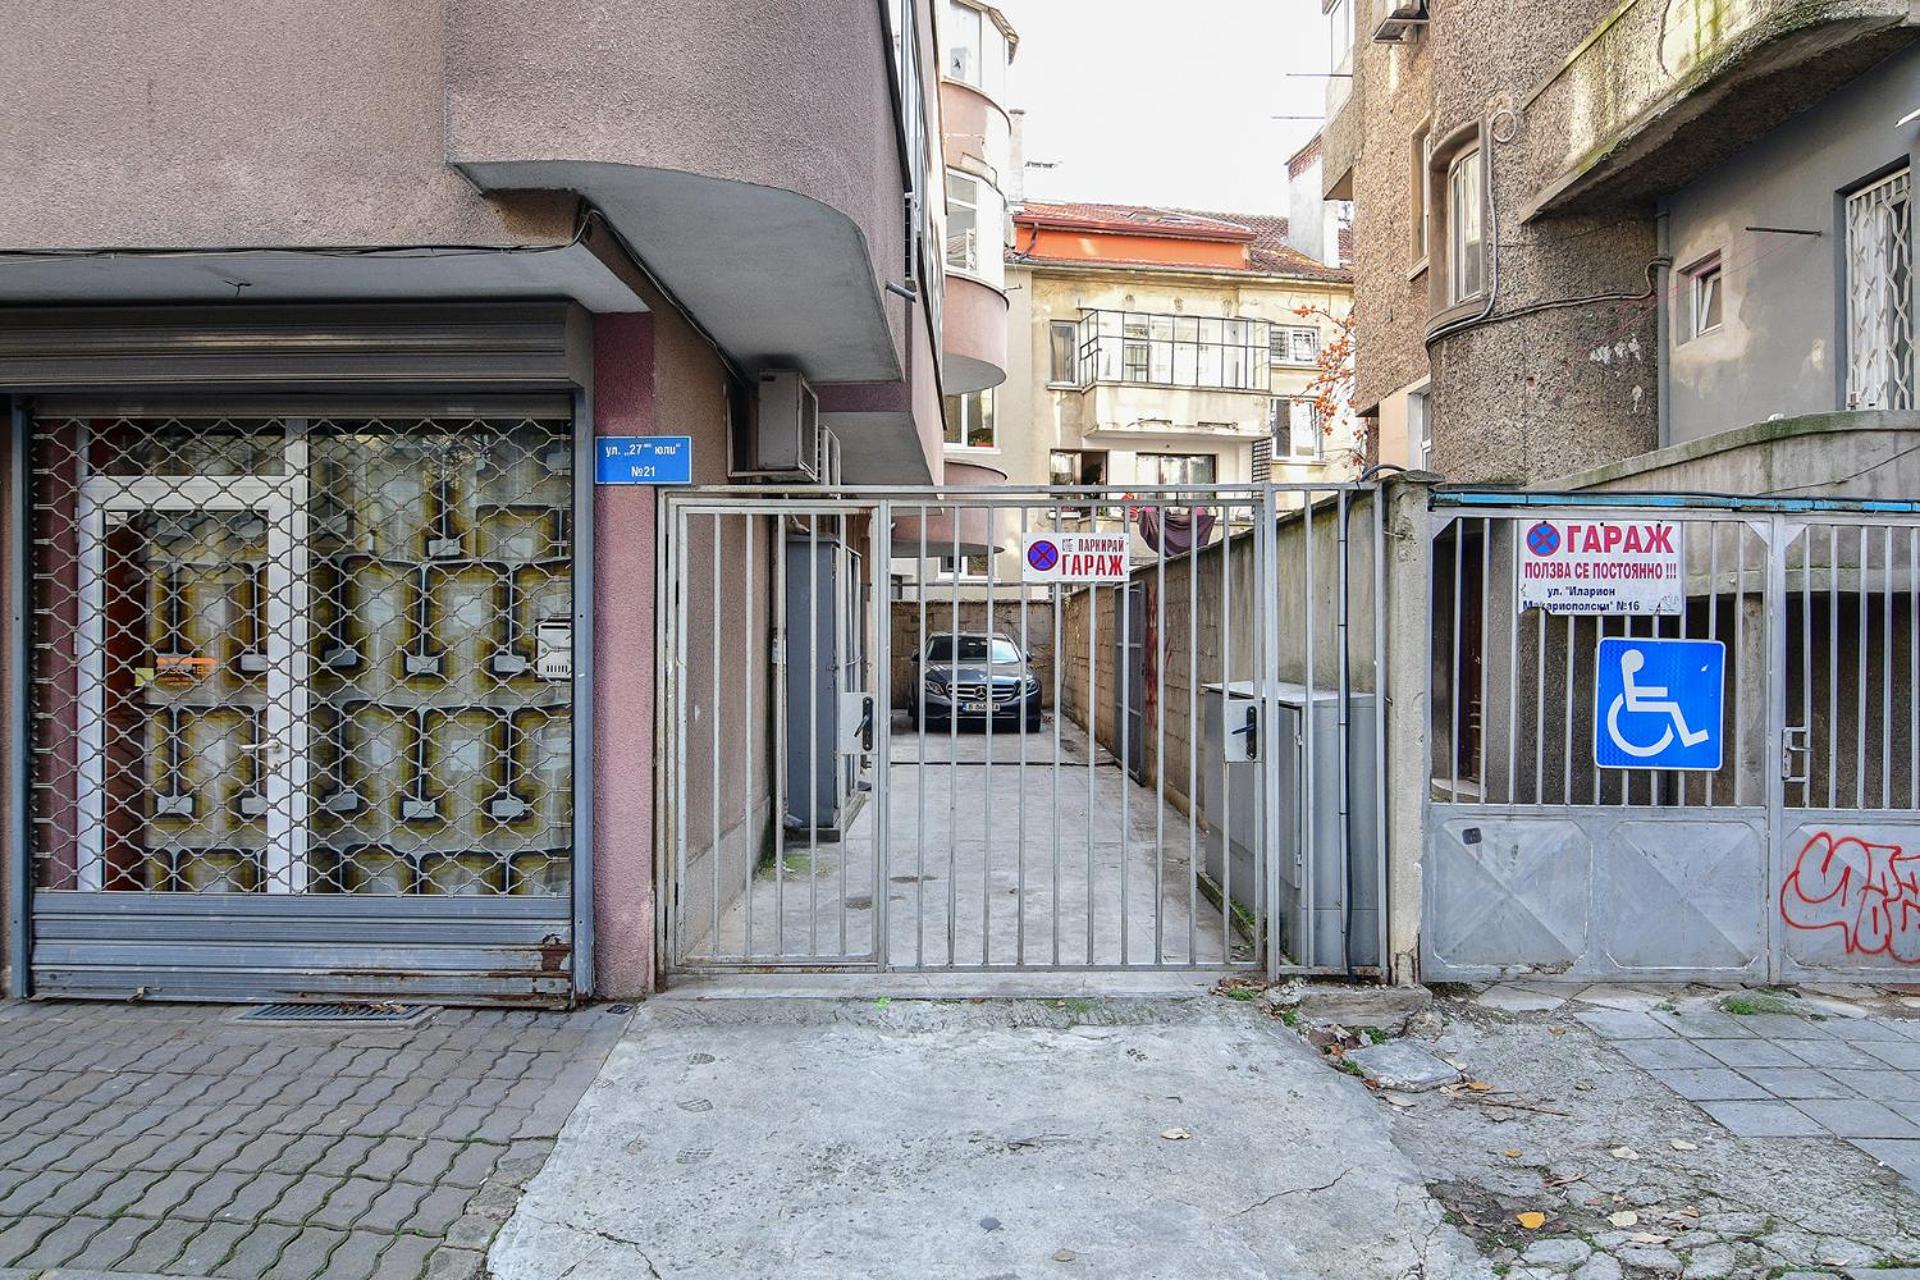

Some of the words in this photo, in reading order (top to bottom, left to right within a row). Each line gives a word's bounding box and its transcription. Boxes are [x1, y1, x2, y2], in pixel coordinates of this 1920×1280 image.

[605, 446, 621, 458] ул.
[631, 465, 655, 477] №21
[1078, 537, 1124, 552] ПАРКИРАЙ
[1567, 525, 1675, 554] ГАРАЖ
[1062, 554, 1123, 576] ГАРАЖ
[1524, 562, 1571, 579] ПОЛЗВА
[1575, 562, 1589, 579] СЕ
[1593, 562, 1663, 579] ПОСТОЯННО
[1666, 563, 1677, 579] !!!
[1547, 587, 1563, 598] ул.
[1616, 601, 1640, 611] №16
